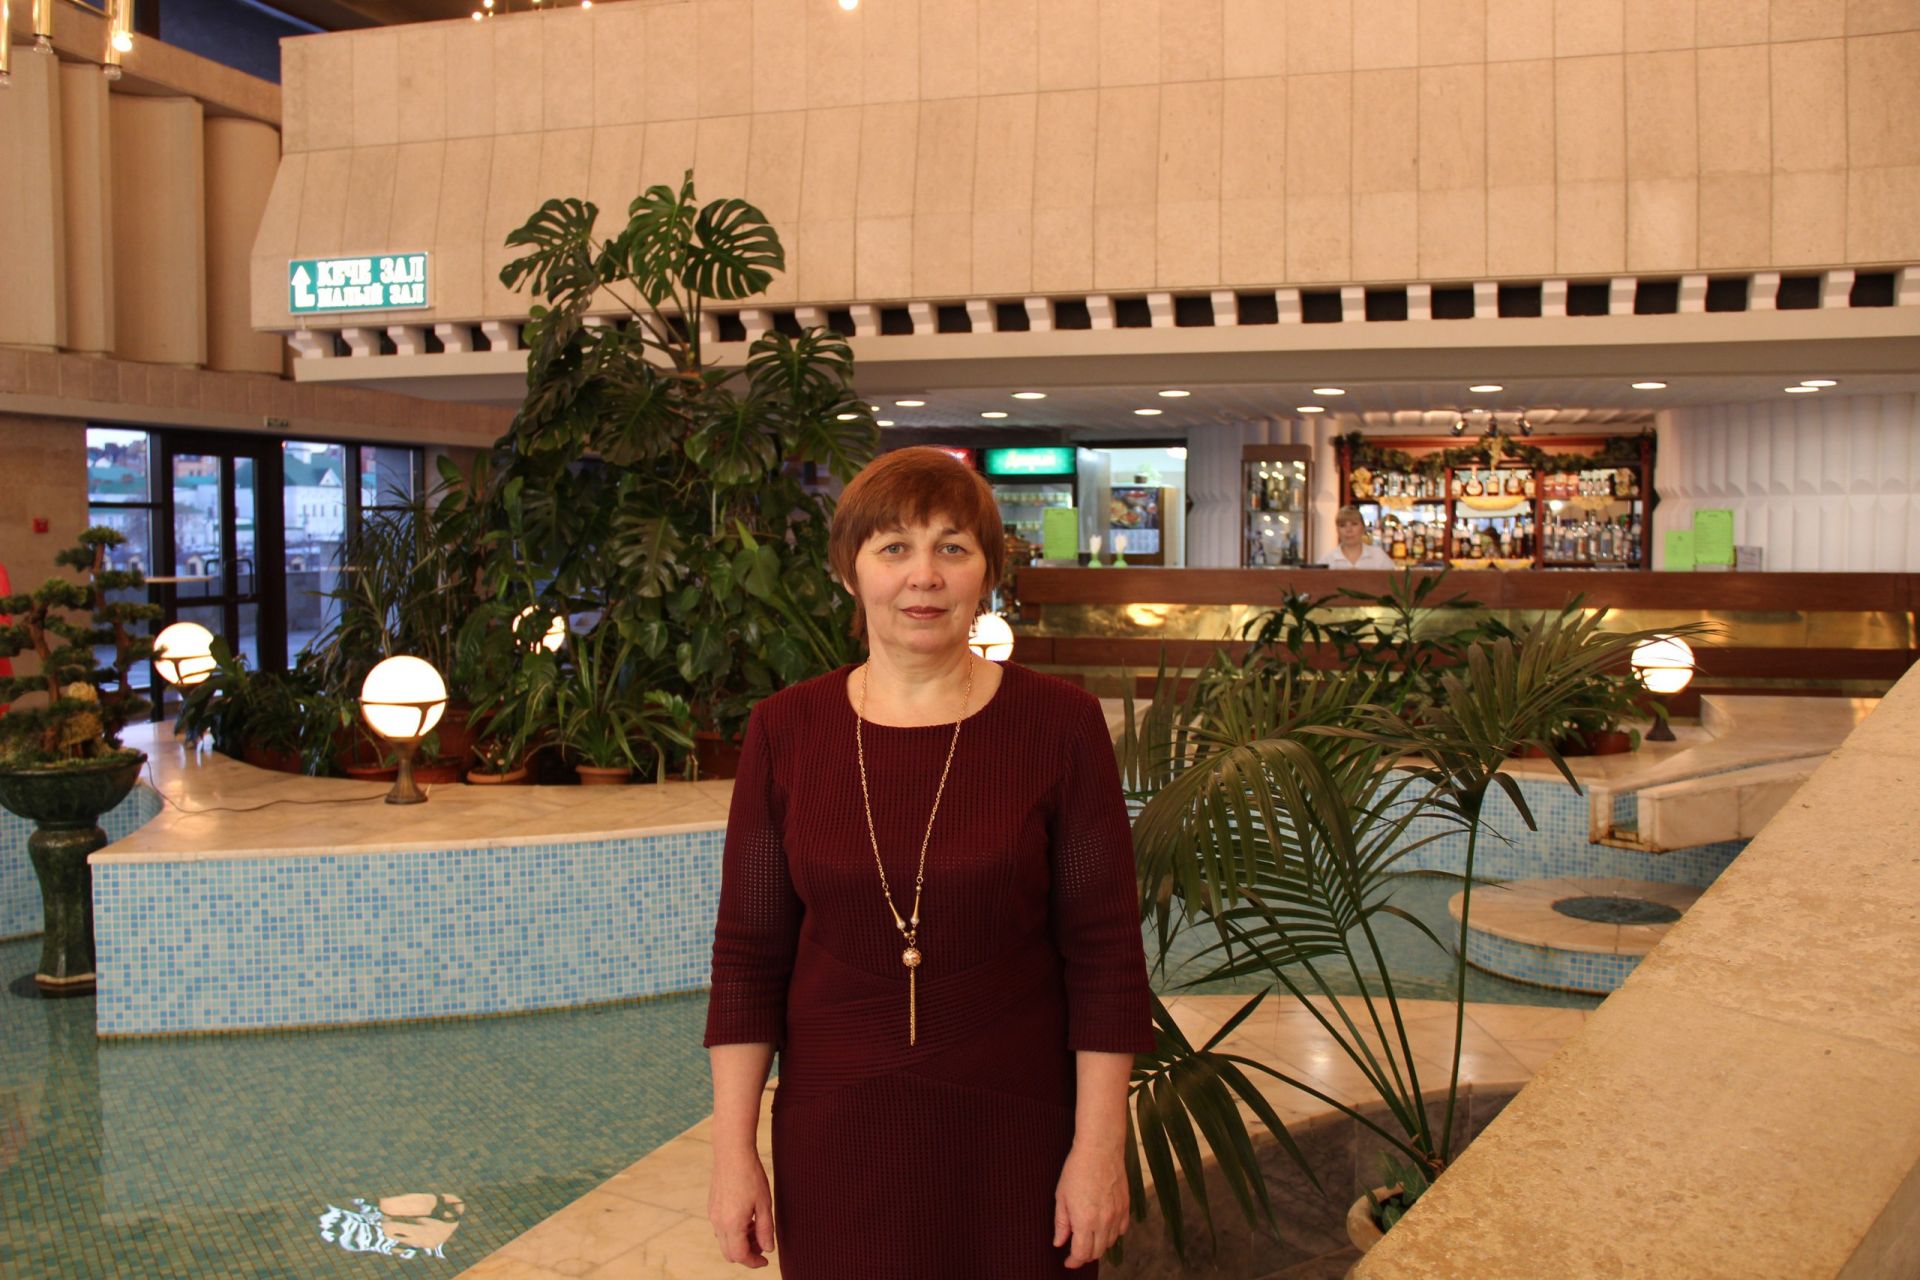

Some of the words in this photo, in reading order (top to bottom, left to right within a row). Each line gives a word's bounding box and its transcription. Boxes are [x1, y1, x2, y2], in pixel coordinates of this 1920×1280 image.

[317, 259, 372, 287] КЕЧЕ
[380, 256, 424, 284] ЗАЛ
[317, 283, 384, 308] МАЛЫЙ
[389, 283, 424, 304] ЗАЛ
